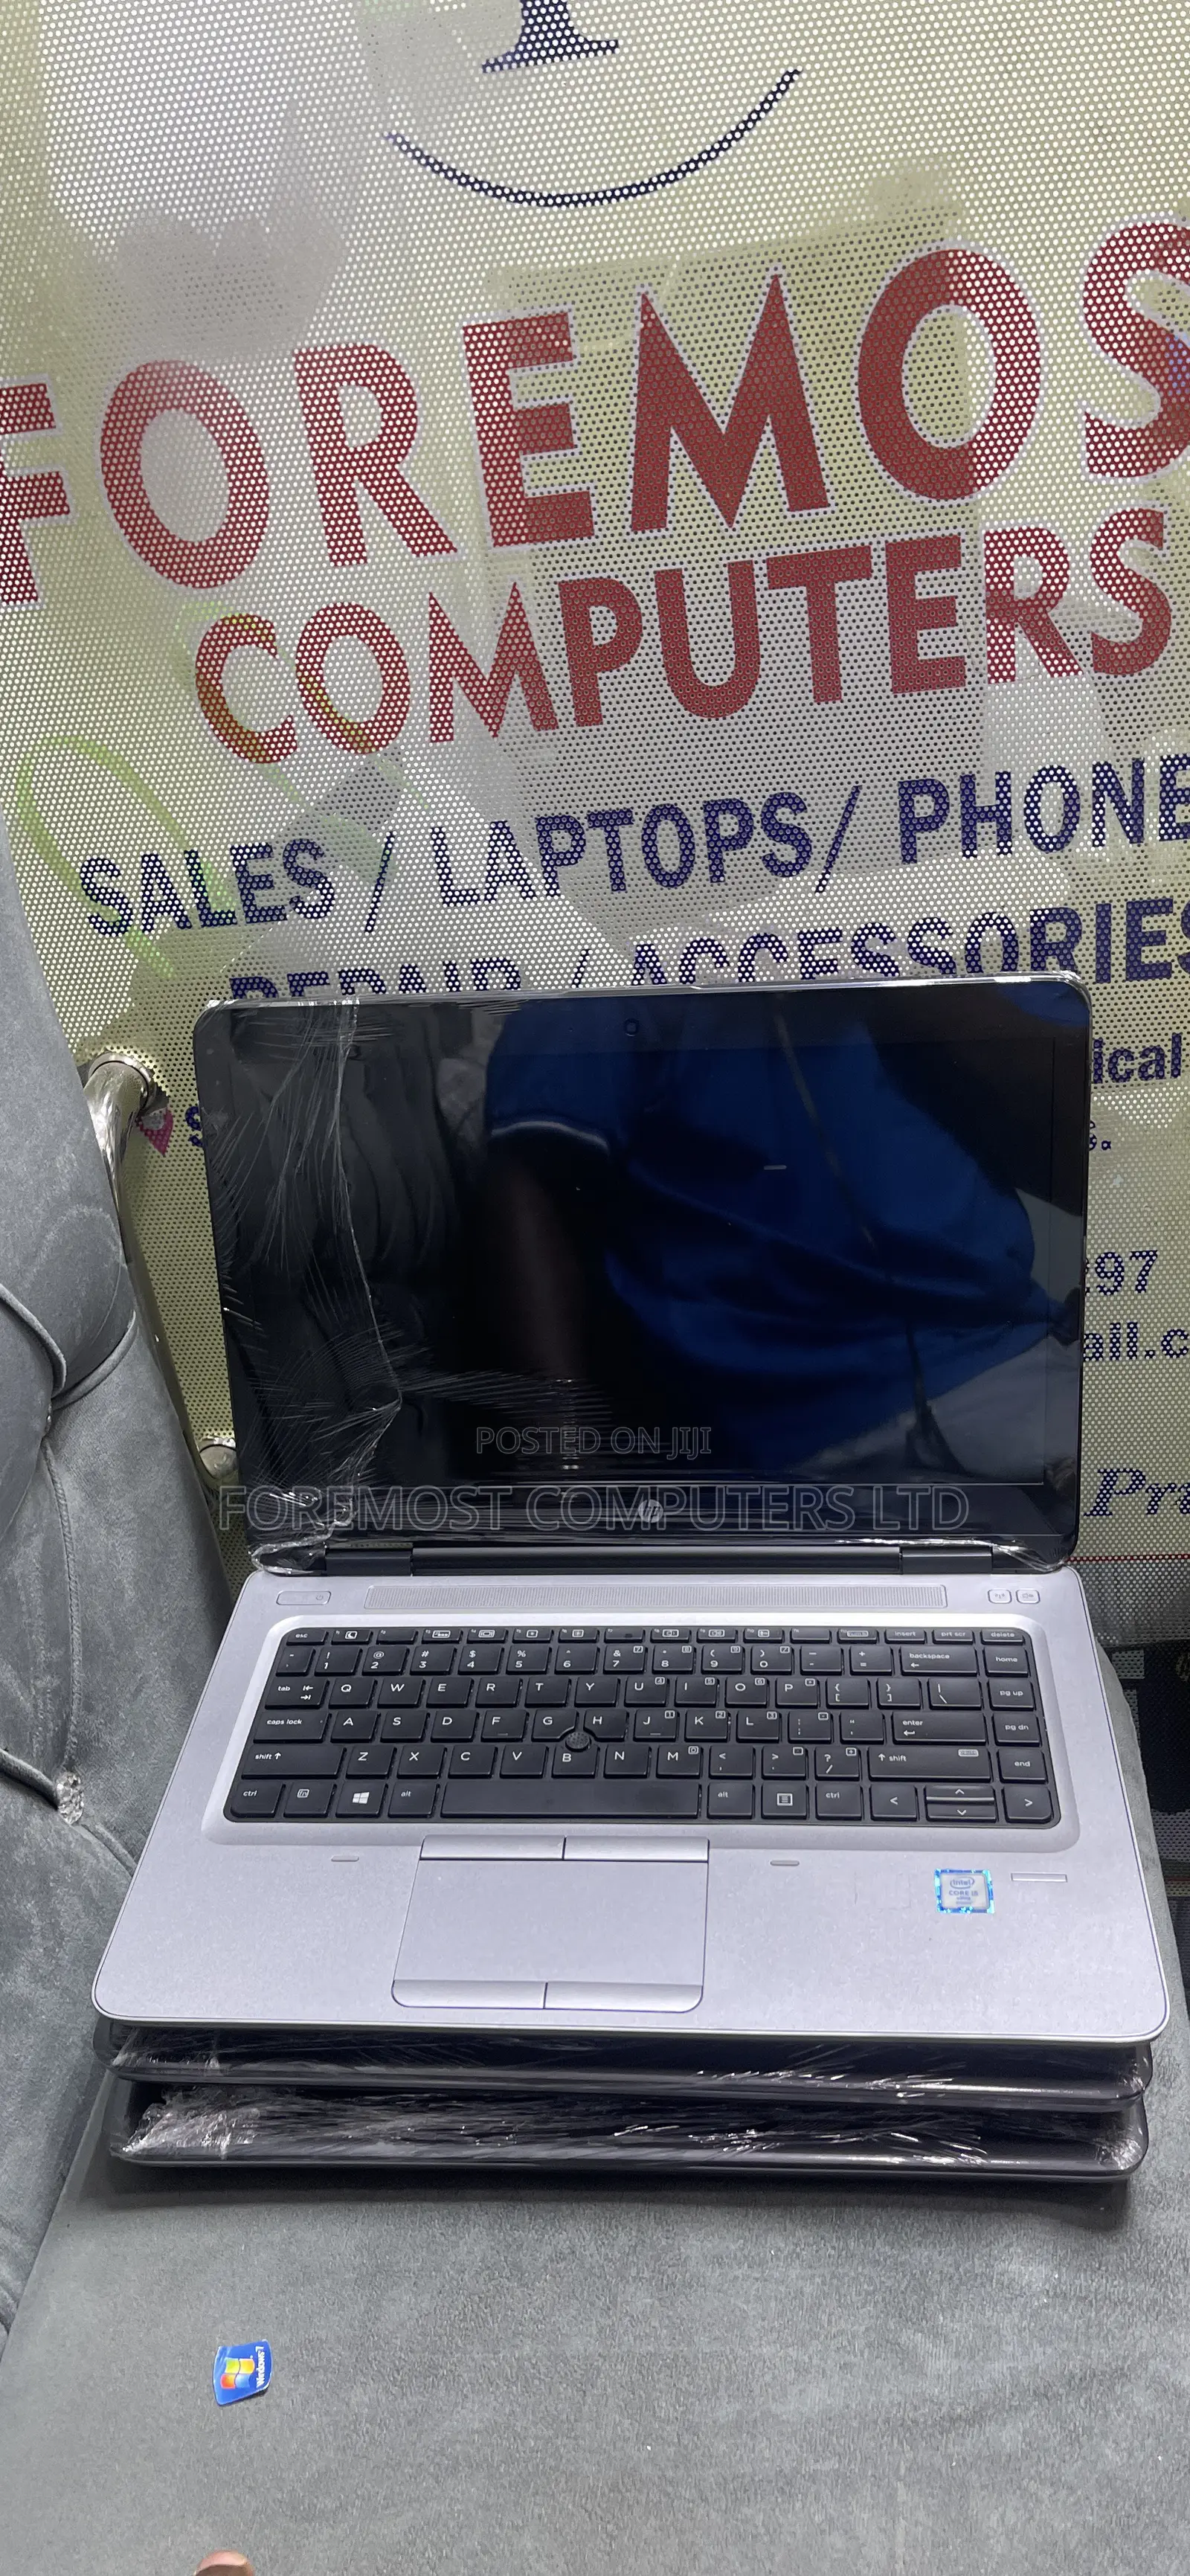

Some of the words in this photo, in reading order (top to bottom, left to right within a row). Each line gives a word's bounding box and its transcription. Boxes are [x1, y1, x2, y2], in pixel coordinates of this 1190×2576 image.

[195, 506, 1171, 764] COMPUTERS
[80, 839, 335, 937] SALES
[344, 1718, 353, 1726] A
[443, 1717, 452, 1725] D
[543, 1717, 553, 1725] G
[593, 1716, 602, 1724] H
[695, 1717, 703, 1725] K
[746, 1717, 753, 1725] L
[358, 1753, 368, 1761] Z
[409, 1753, 419, 1761] X
[461, 1752, 470, 1760] C
[512, 1752, 522, 1760] V
[562, 1753, 571, 1761] B
[615, 1752, 624, 1760] N
[668, 1752, 678, 1761] M
